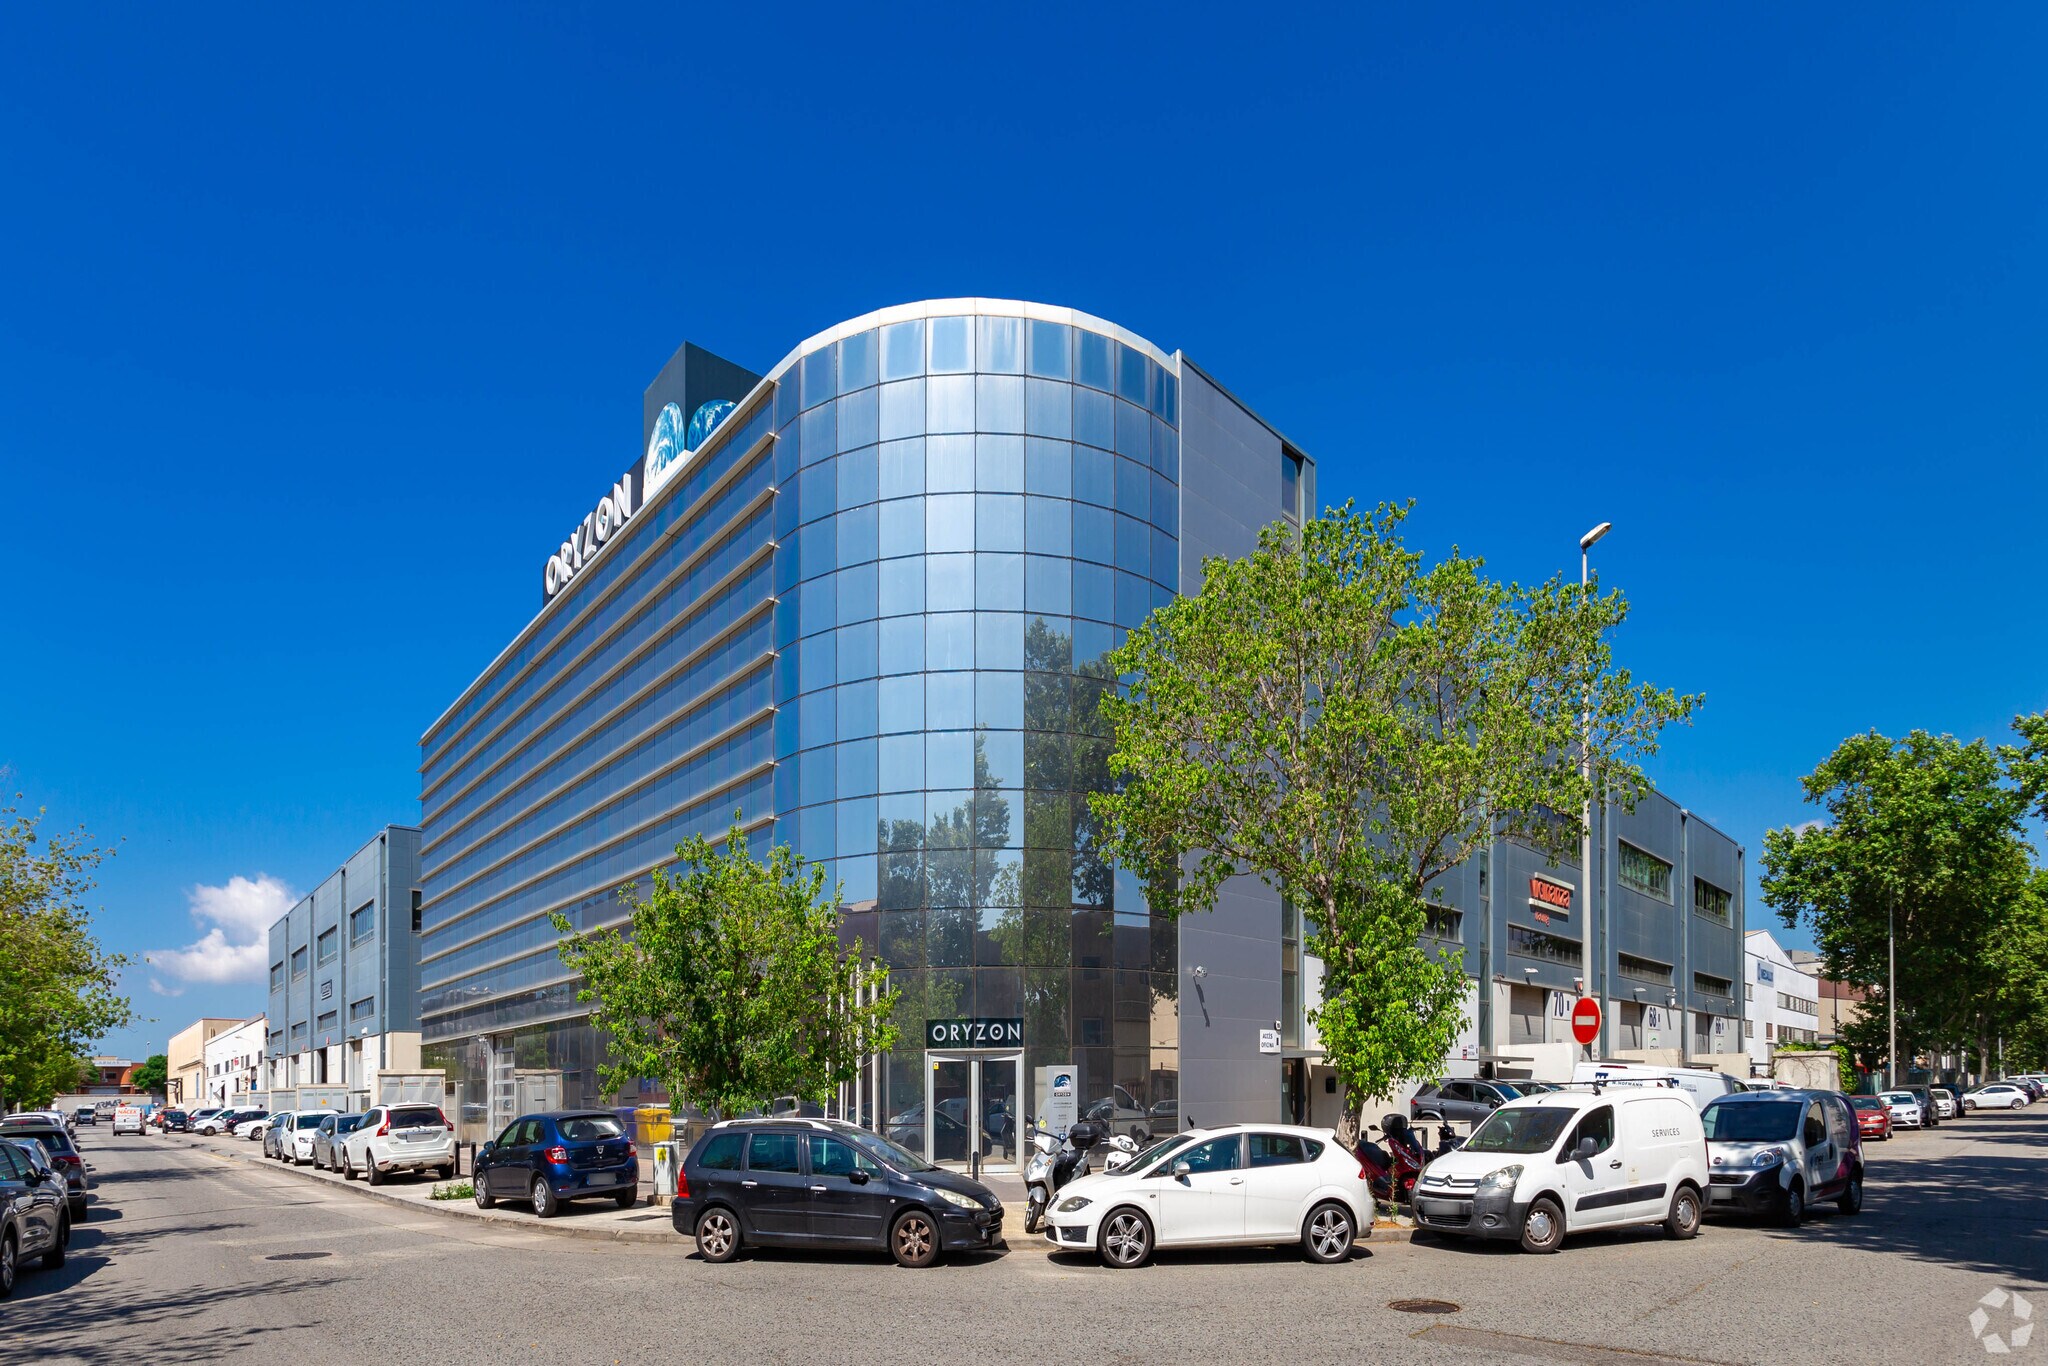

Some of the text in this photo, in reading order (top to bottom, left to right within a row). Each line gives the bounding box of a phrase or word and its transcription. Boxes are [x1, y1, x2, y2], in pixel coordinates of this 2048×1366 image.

[545, 473, 631, 596] ORYZON
[1554, 992, 1564, 1017] 70
[1649, 1007, 1657, 1028] 68
[1716, 1017, 1721, 1034] 66
[932, 1023, 1020, 1041] ORYZON
[1651, 1127, 1681, 1138] SERVICES
